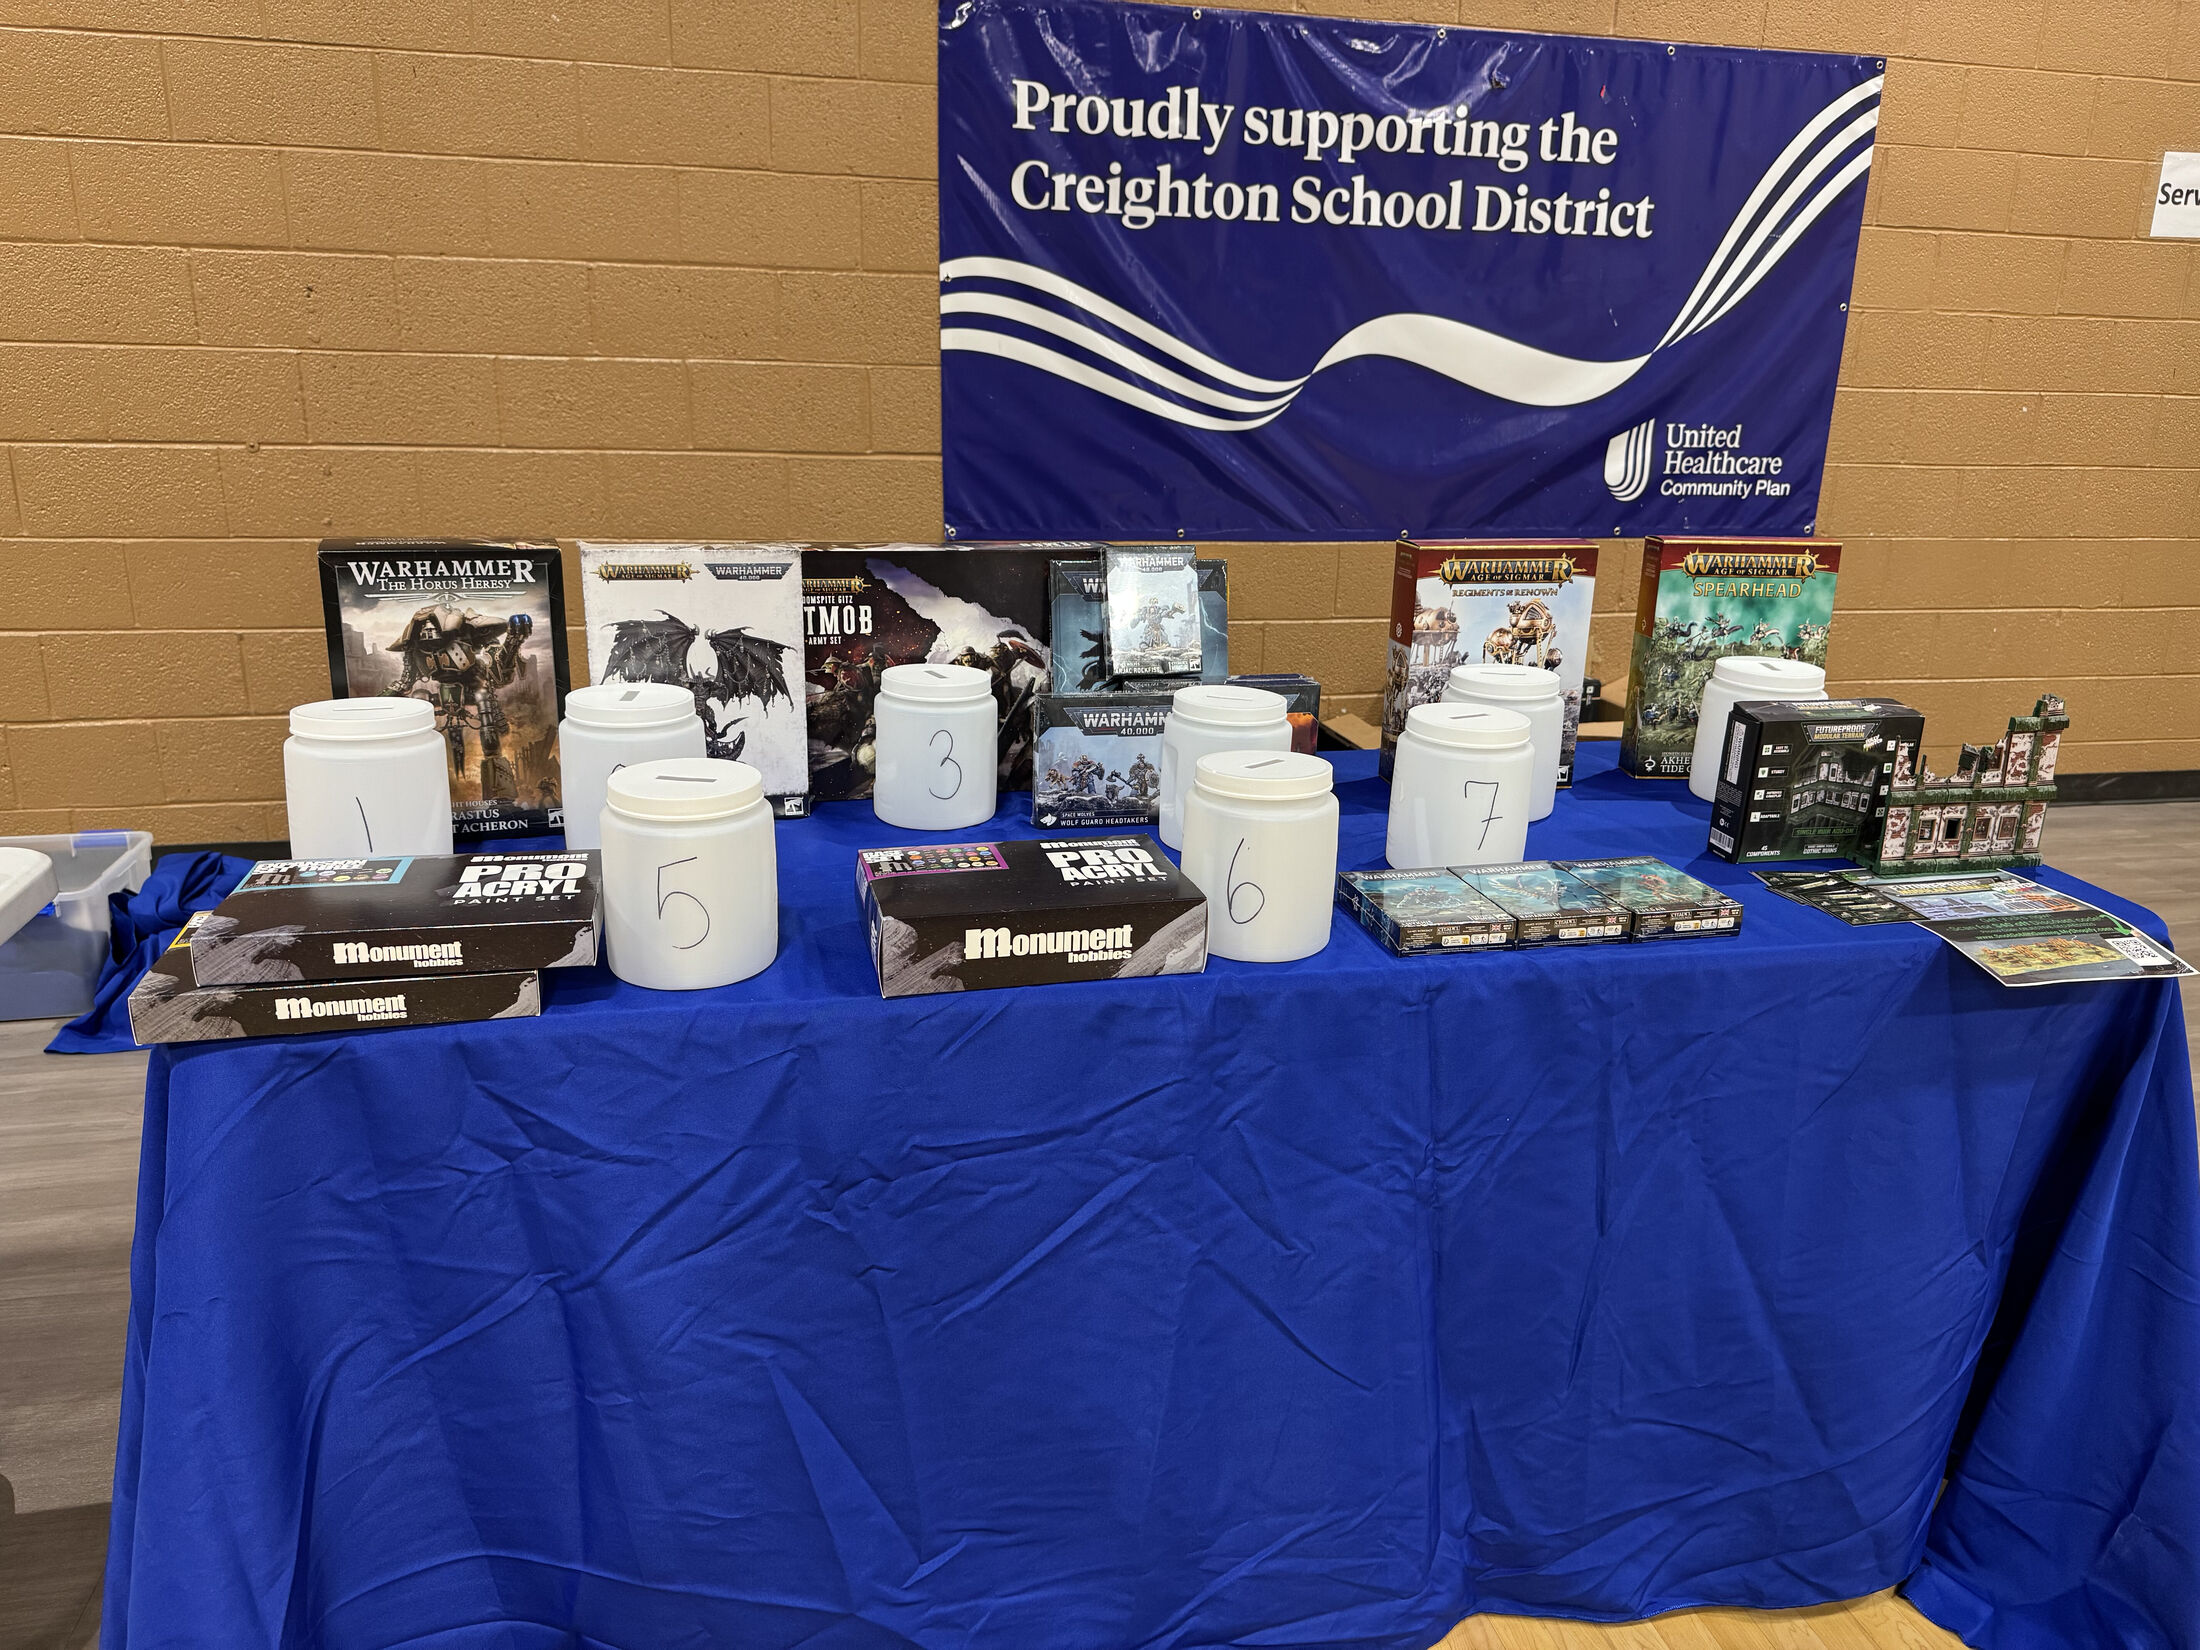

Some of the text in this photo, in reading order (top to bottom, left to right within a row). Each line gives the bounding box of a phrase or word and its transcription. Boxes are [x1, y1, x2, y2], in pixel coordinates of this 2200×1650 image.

[1012, 79, 1619, 173] Proudly supporting the
[1010, 160, 1655, 239] Creighton School District
[2158, 182, 2200, 207] Serv
[1666, 423, 1743, 449] United
[1662, 450, 1783, 476] Healthcare
[1660, 478, 1791, 499] Community Plan
[347, 558, 536, 586] WARHAMMER
[600, 563, 690, 581] WARHAMMER
[715, 566, 782, 576] WARHAMMER
[1441, 559, 1572, 581] WARHAMMER
[1685, 553, 1813, 577] WARHAMMER
[1714, 568, 1734, 576] AGE
[1747, 567, 1788, 576] SIGMAR
[411, 578, 458, 592] HORUS
[462, 576, 513, 591] HERESY
[1471, 573, 1486, 581] AGE
[1504, 573, 1545, 581] SIGMAR
[1452, 588, 1505, 598] REGIMENTS
[1514, 587, 1559, 597] RENOWN
[1693, 581, 1802, 598] SPEARHEAD
[804, 605, 873, 636] TMOB
[808, 636, 842, 646] ARMY SET
[1083, 711, 1171, 728] WARHAMM
[1815, 724, 1866, 734] FUTUREPROOF
[928, 729, 963, 801] 3
[1660, 756, 1691, 765] AKHE
[1660, 764, 1685, 773] TIDE
[451, 808, 500, 821] RASTUS
[1060, 816, 1149, 827] WOLF GUARD HEADTAKERS
[1463, 780, 1504, 851] 7
[462, 819, 528, 834] ACHERON
[1045, 847, 1154, 868] PRO
[1746, 850, 1780, 858] COMPONENTS
[459, 862, 587, 883] PRO
[1060, 862, 1168, 881] ACRYL
[452, 879, 582, 899] ACRYL
[1070, 878, 1126, 887] PAINT
[1227, 837, 1265, 925] 6
[453, 894, 577, 905] PAINT SET
[657, 856, 710, 950] 5
[413, 957, 464, 968] hobbies
[1068, 948, 1133, 964] hobbies
[356, 1008, 408, 1022] hobbies
